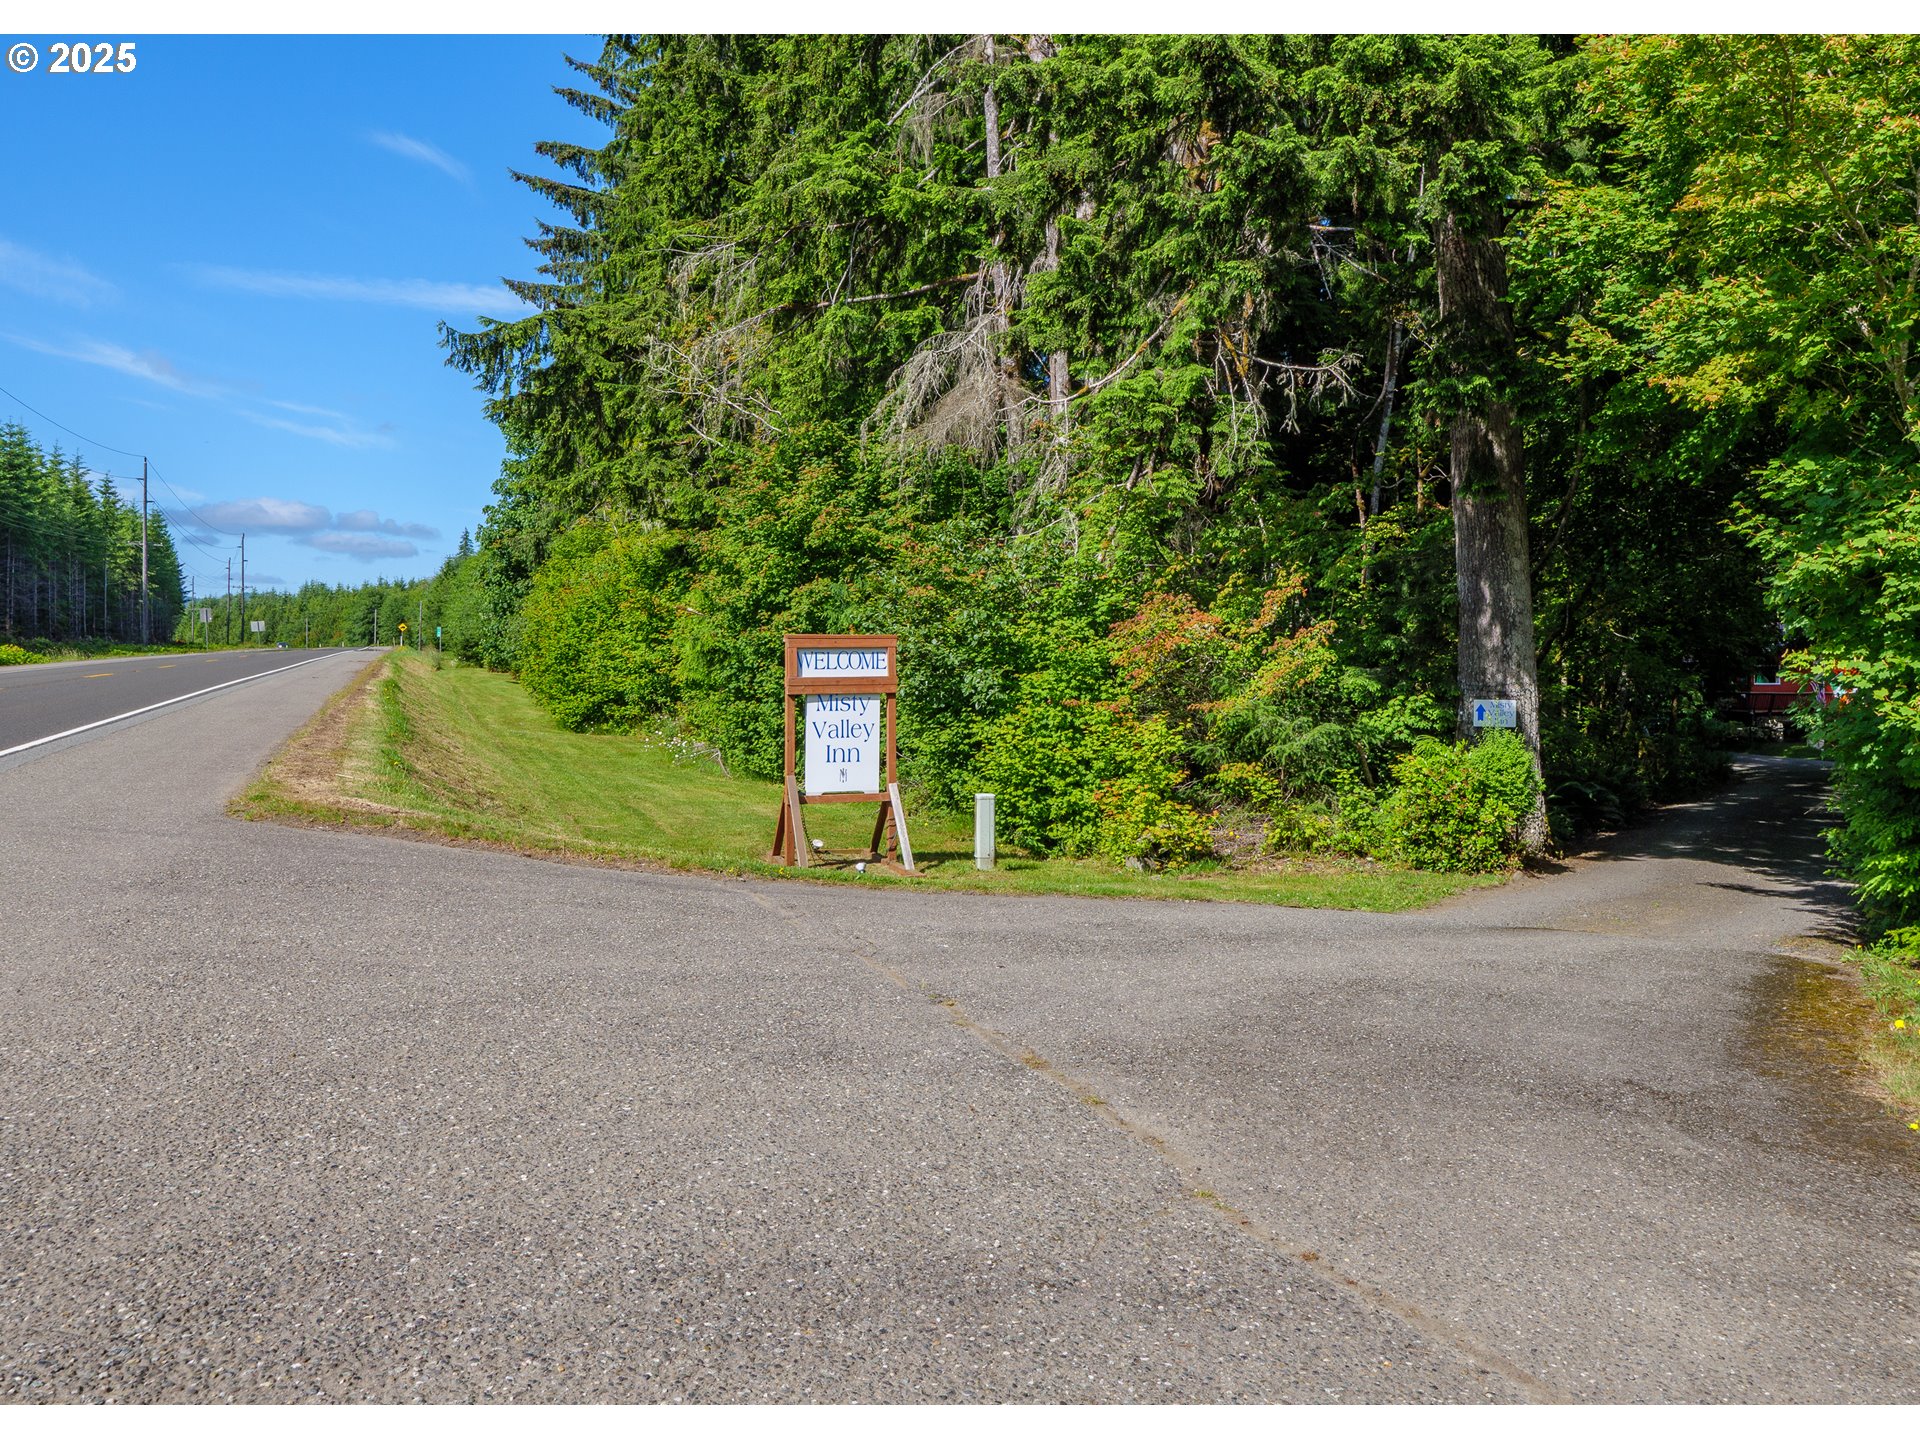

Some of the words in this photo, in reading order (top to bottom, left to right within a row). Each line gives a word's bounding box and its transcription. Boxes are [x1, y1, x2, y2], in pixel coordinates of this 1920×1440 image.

[797, 651, 887, 670] WELCOME
[816, 694, 871, 716] Misty
[812, 719, 874, 742] Valley
[826, 745, 860, 763] Inn
